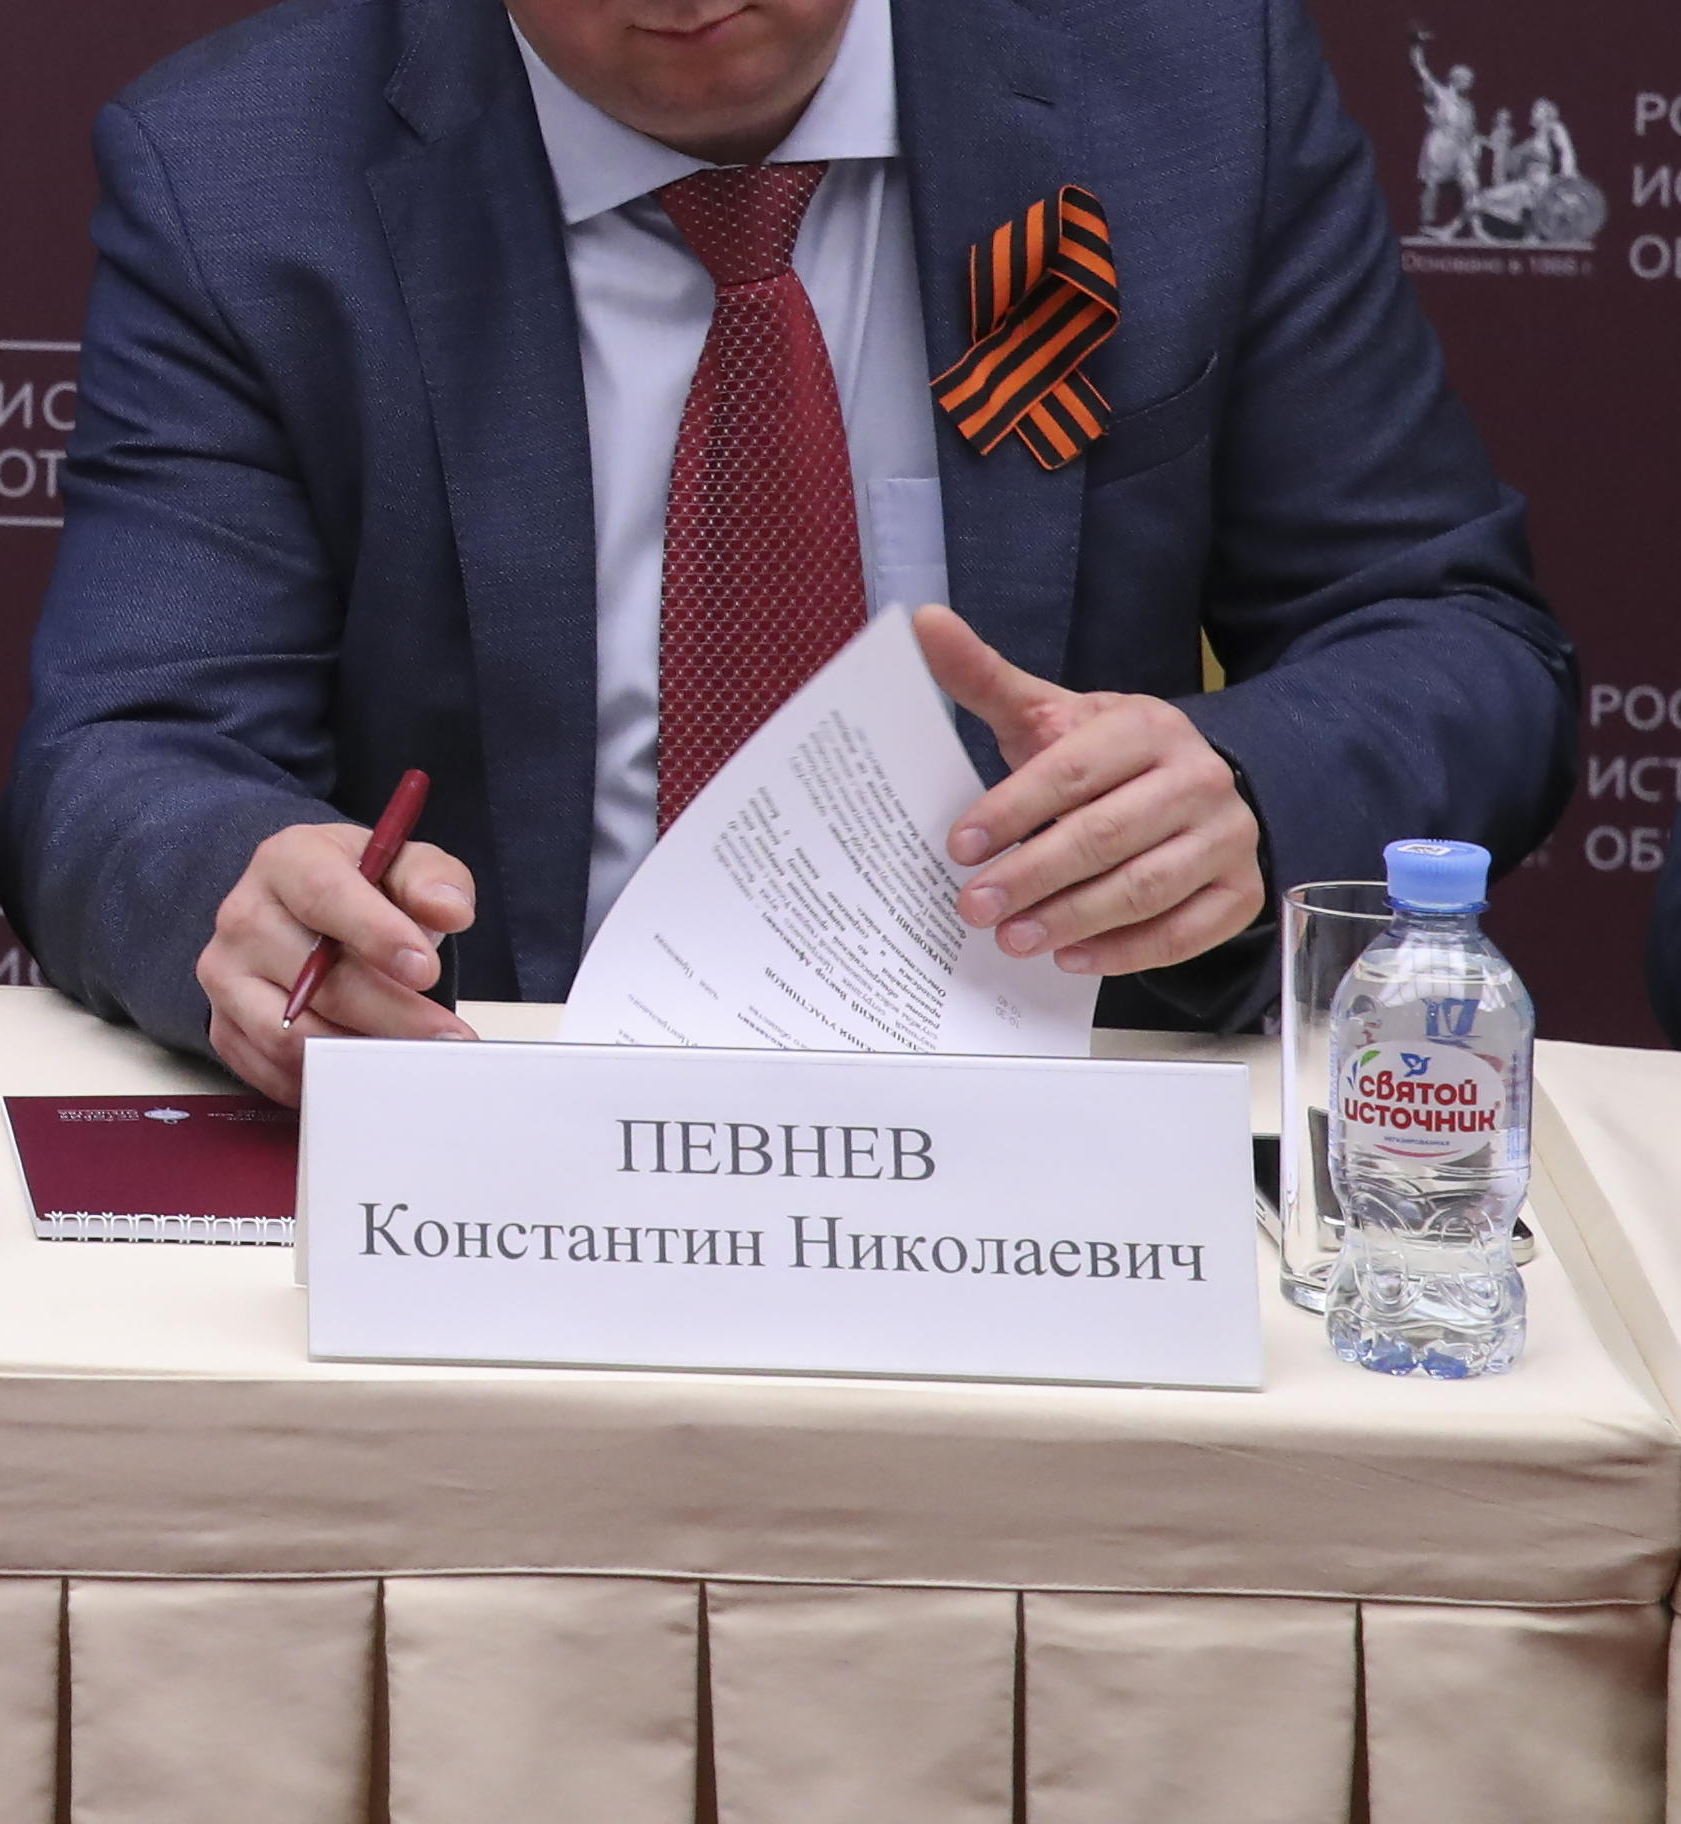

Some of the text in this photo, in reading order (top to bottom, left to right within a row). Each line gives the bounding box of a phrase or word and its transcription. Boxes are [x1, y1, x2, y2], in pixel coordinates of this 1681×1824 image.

[617, 1119, 936, 1181] ПЕВНЕВ
[359, 1202, 1207, 1282] Константин Николаевич
